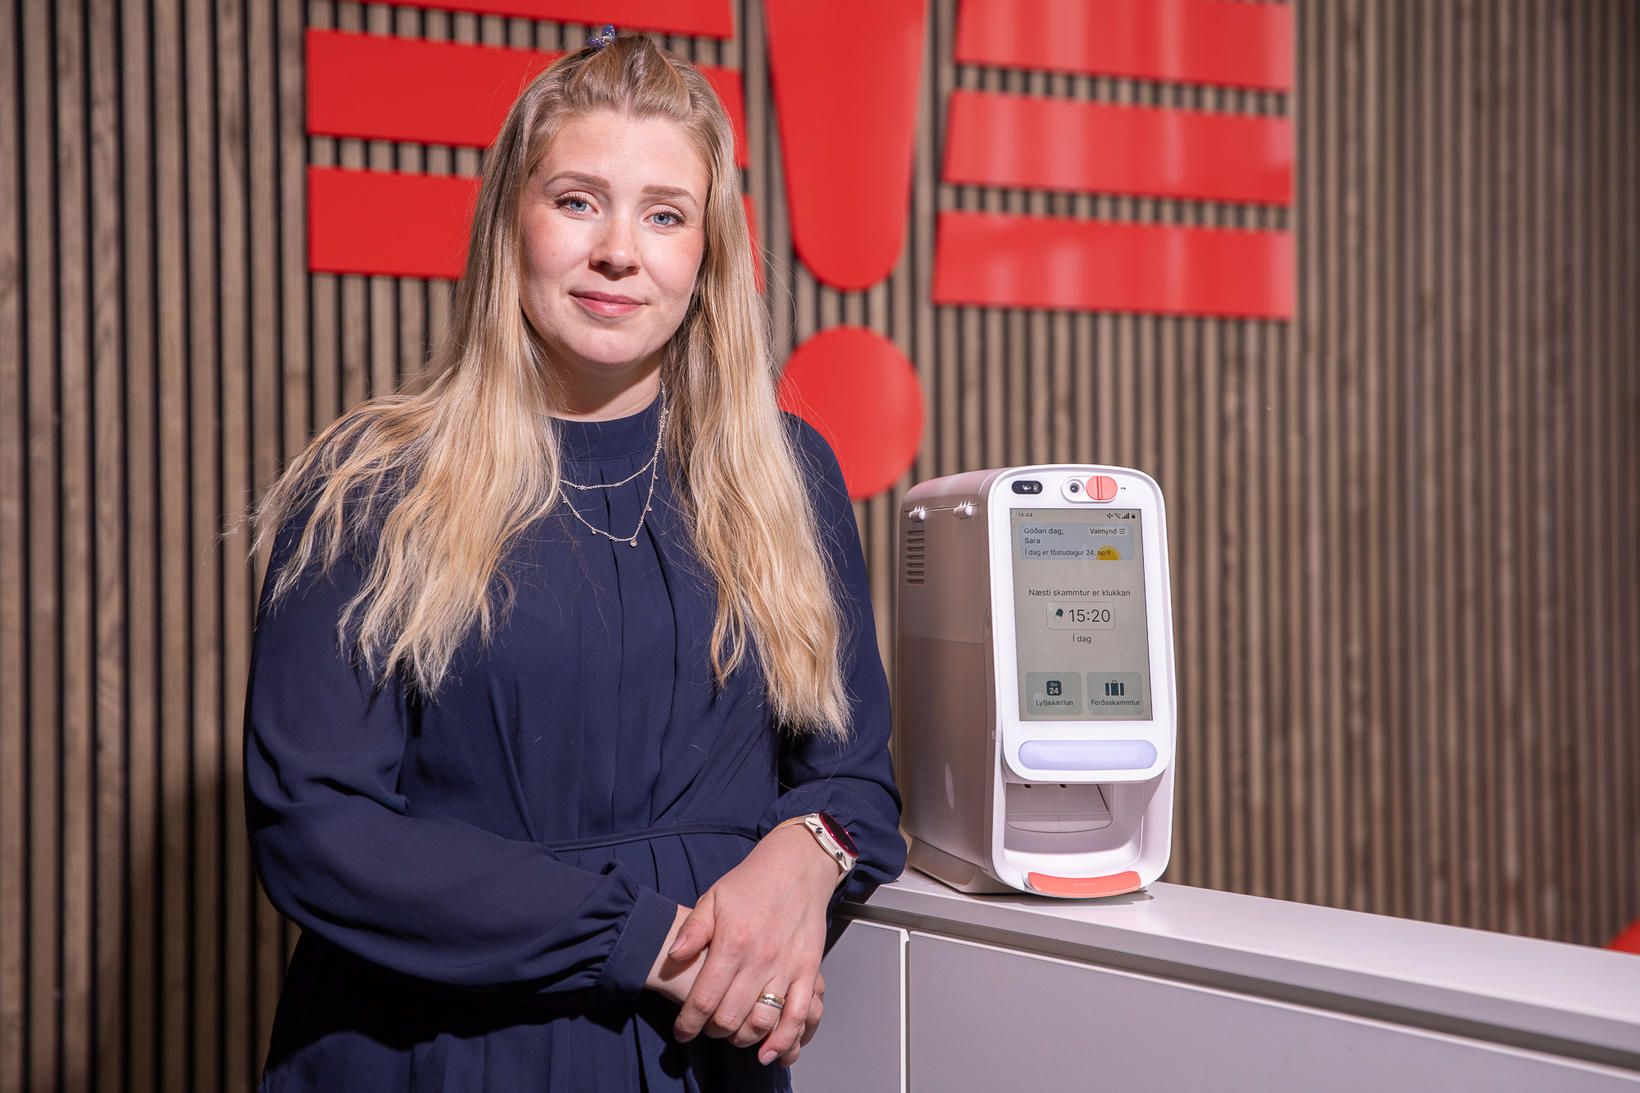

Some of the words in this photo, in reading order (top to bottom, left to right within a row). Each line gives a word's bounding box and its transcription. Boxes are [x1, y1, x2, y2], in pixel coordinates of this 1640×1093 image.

[1048, 528, 1064, 536] dag,
[1090, 528, 1117, 536] Valmynd
[1028, 549, 1041, 557] dag
[1050, 549, 1084, 557] föstudagur
[1068, 609, 1111, 622] 15:20
[1076, 635, 1092, 644] dag
